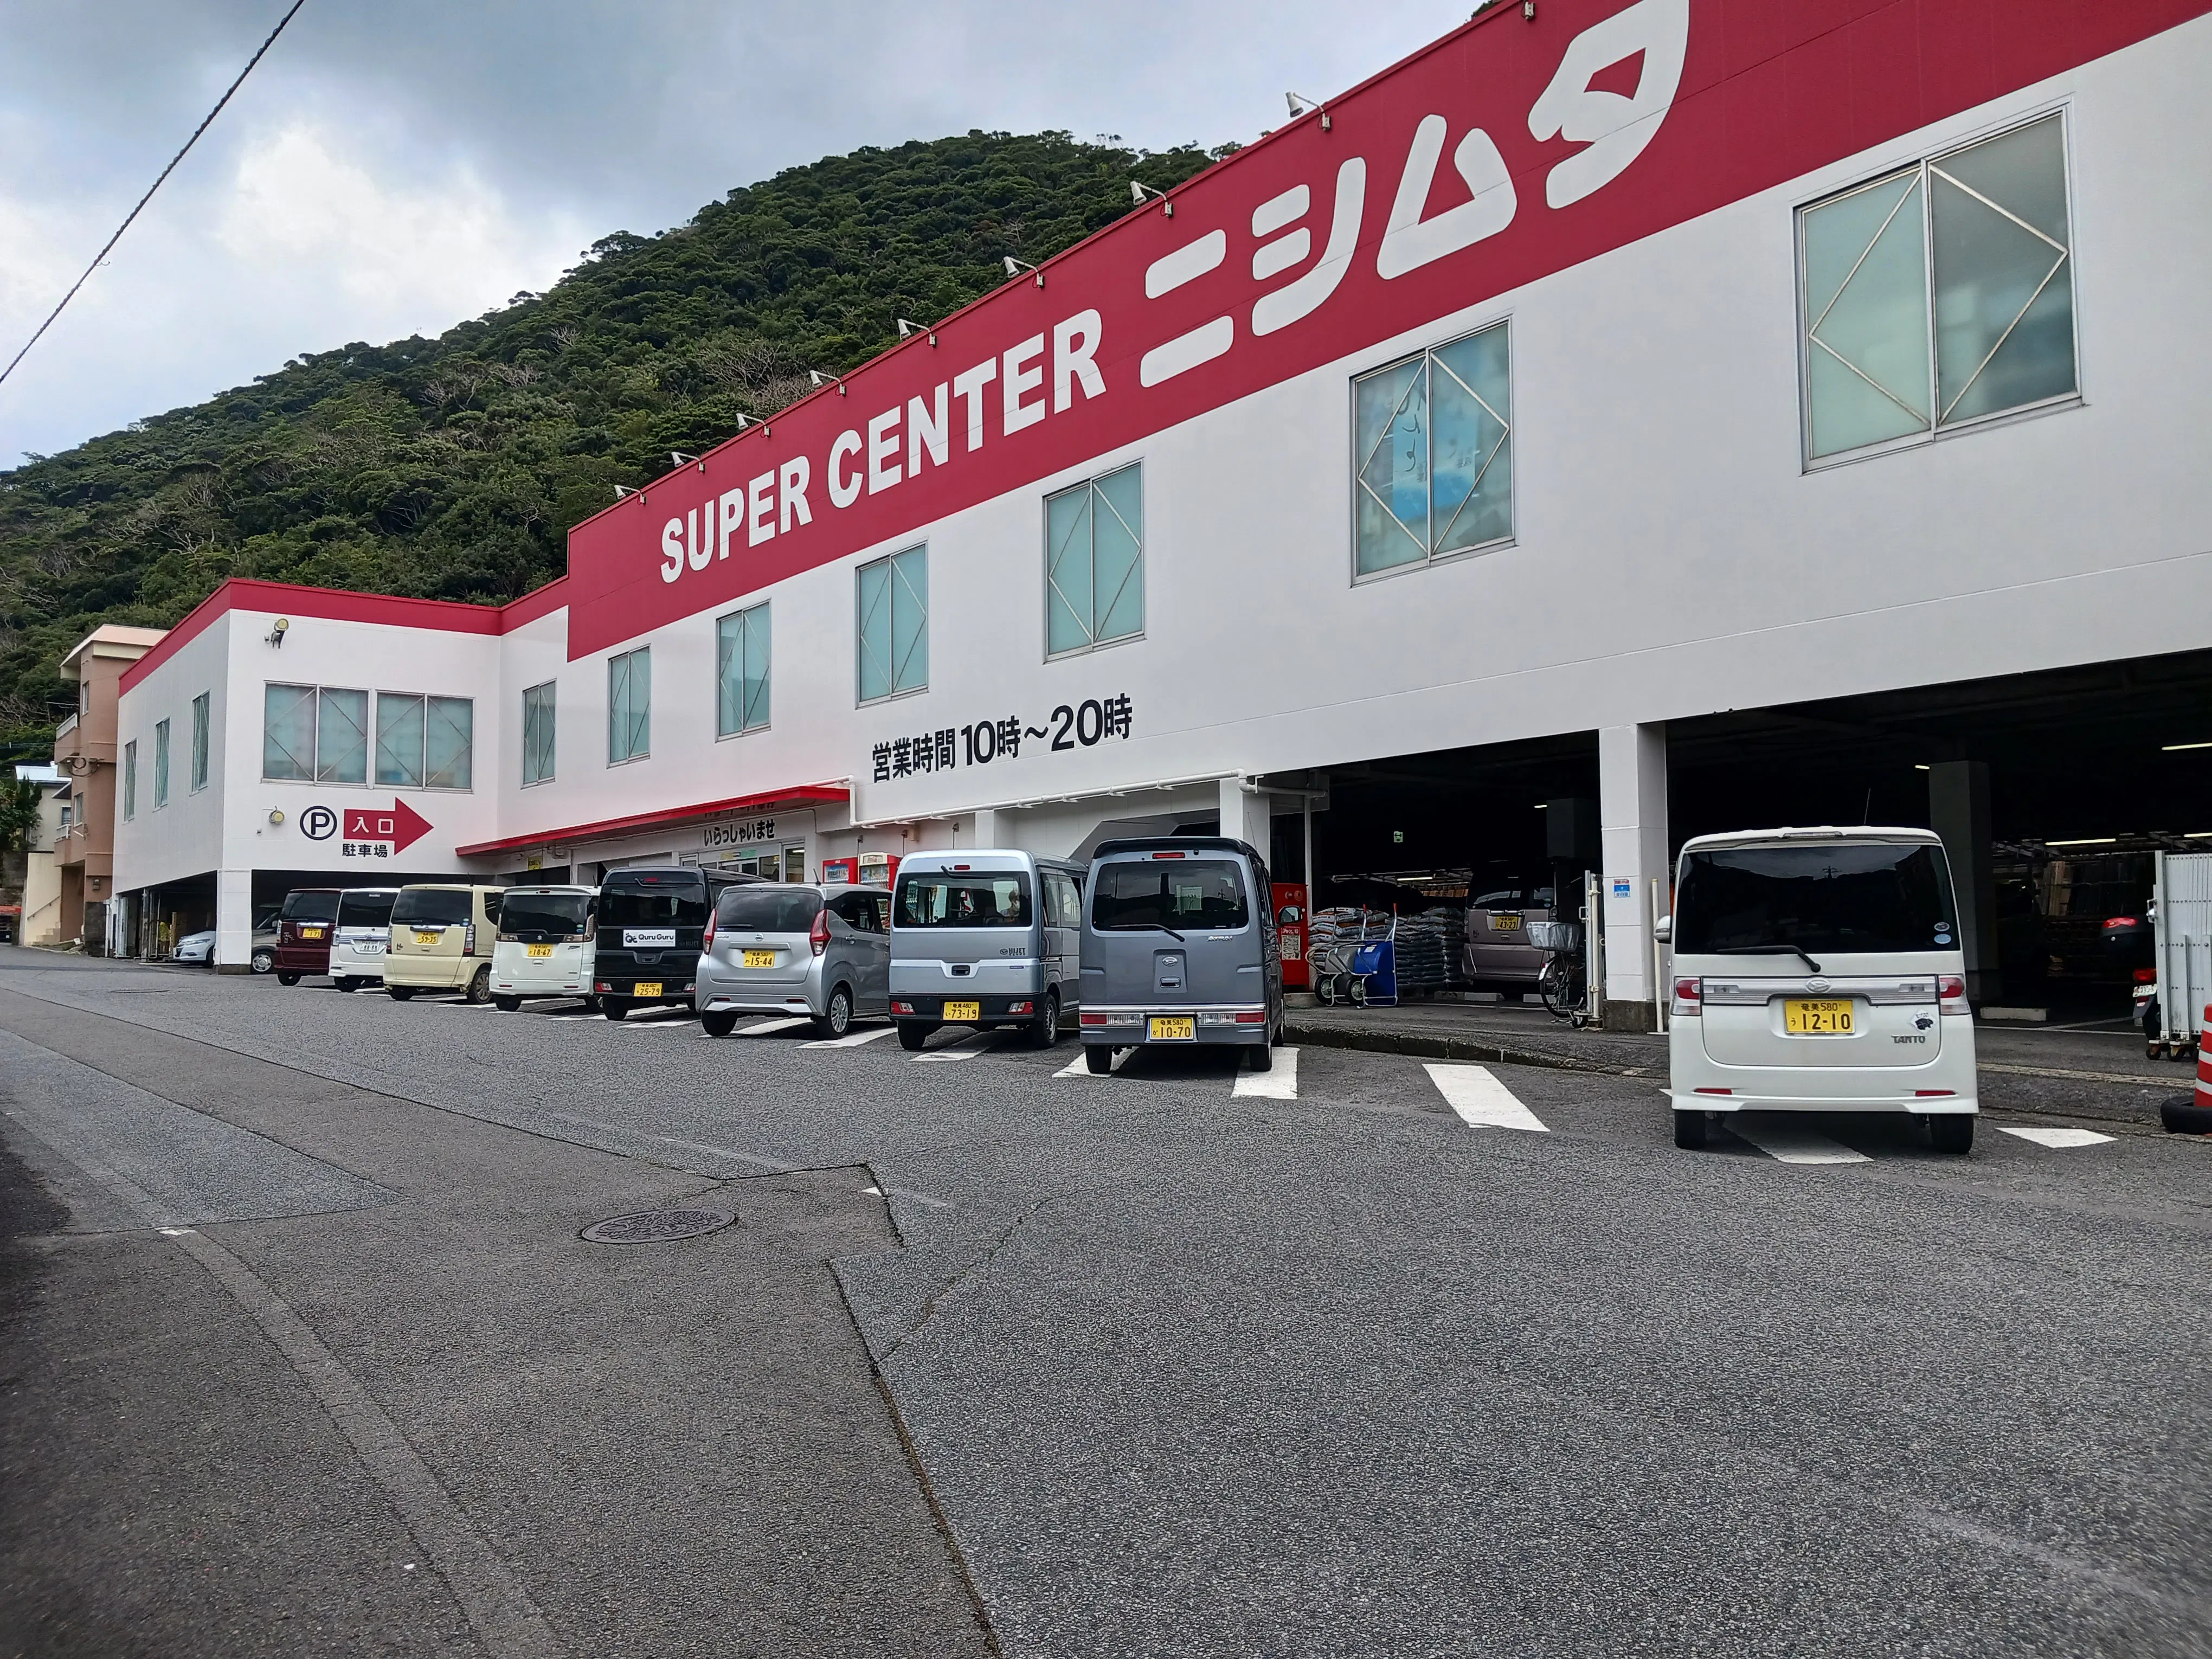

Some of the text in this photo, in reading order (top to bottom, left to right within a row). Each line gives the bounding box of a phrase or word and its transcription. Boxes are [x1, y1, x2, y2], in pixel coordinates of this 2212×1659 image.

[1140, 0, 1690, 389] ニシムタ
[661, 308, 1107, 584] SUPER CENTER
[352, 816, 394, 834] 入口
[704, 819, 775, 847] いらっしゃいませ
[342, 843, 388, 858] 駐車場
[751, 957, 773, 966] 15-44
[951, 1009, 977, 1019] 73-19
[1790, 1013, 1851, 1030] う 12-10
[1161, 1026, 1191, 1038] 10-70
[1891, 1035, 1926, 1044] TANTO
